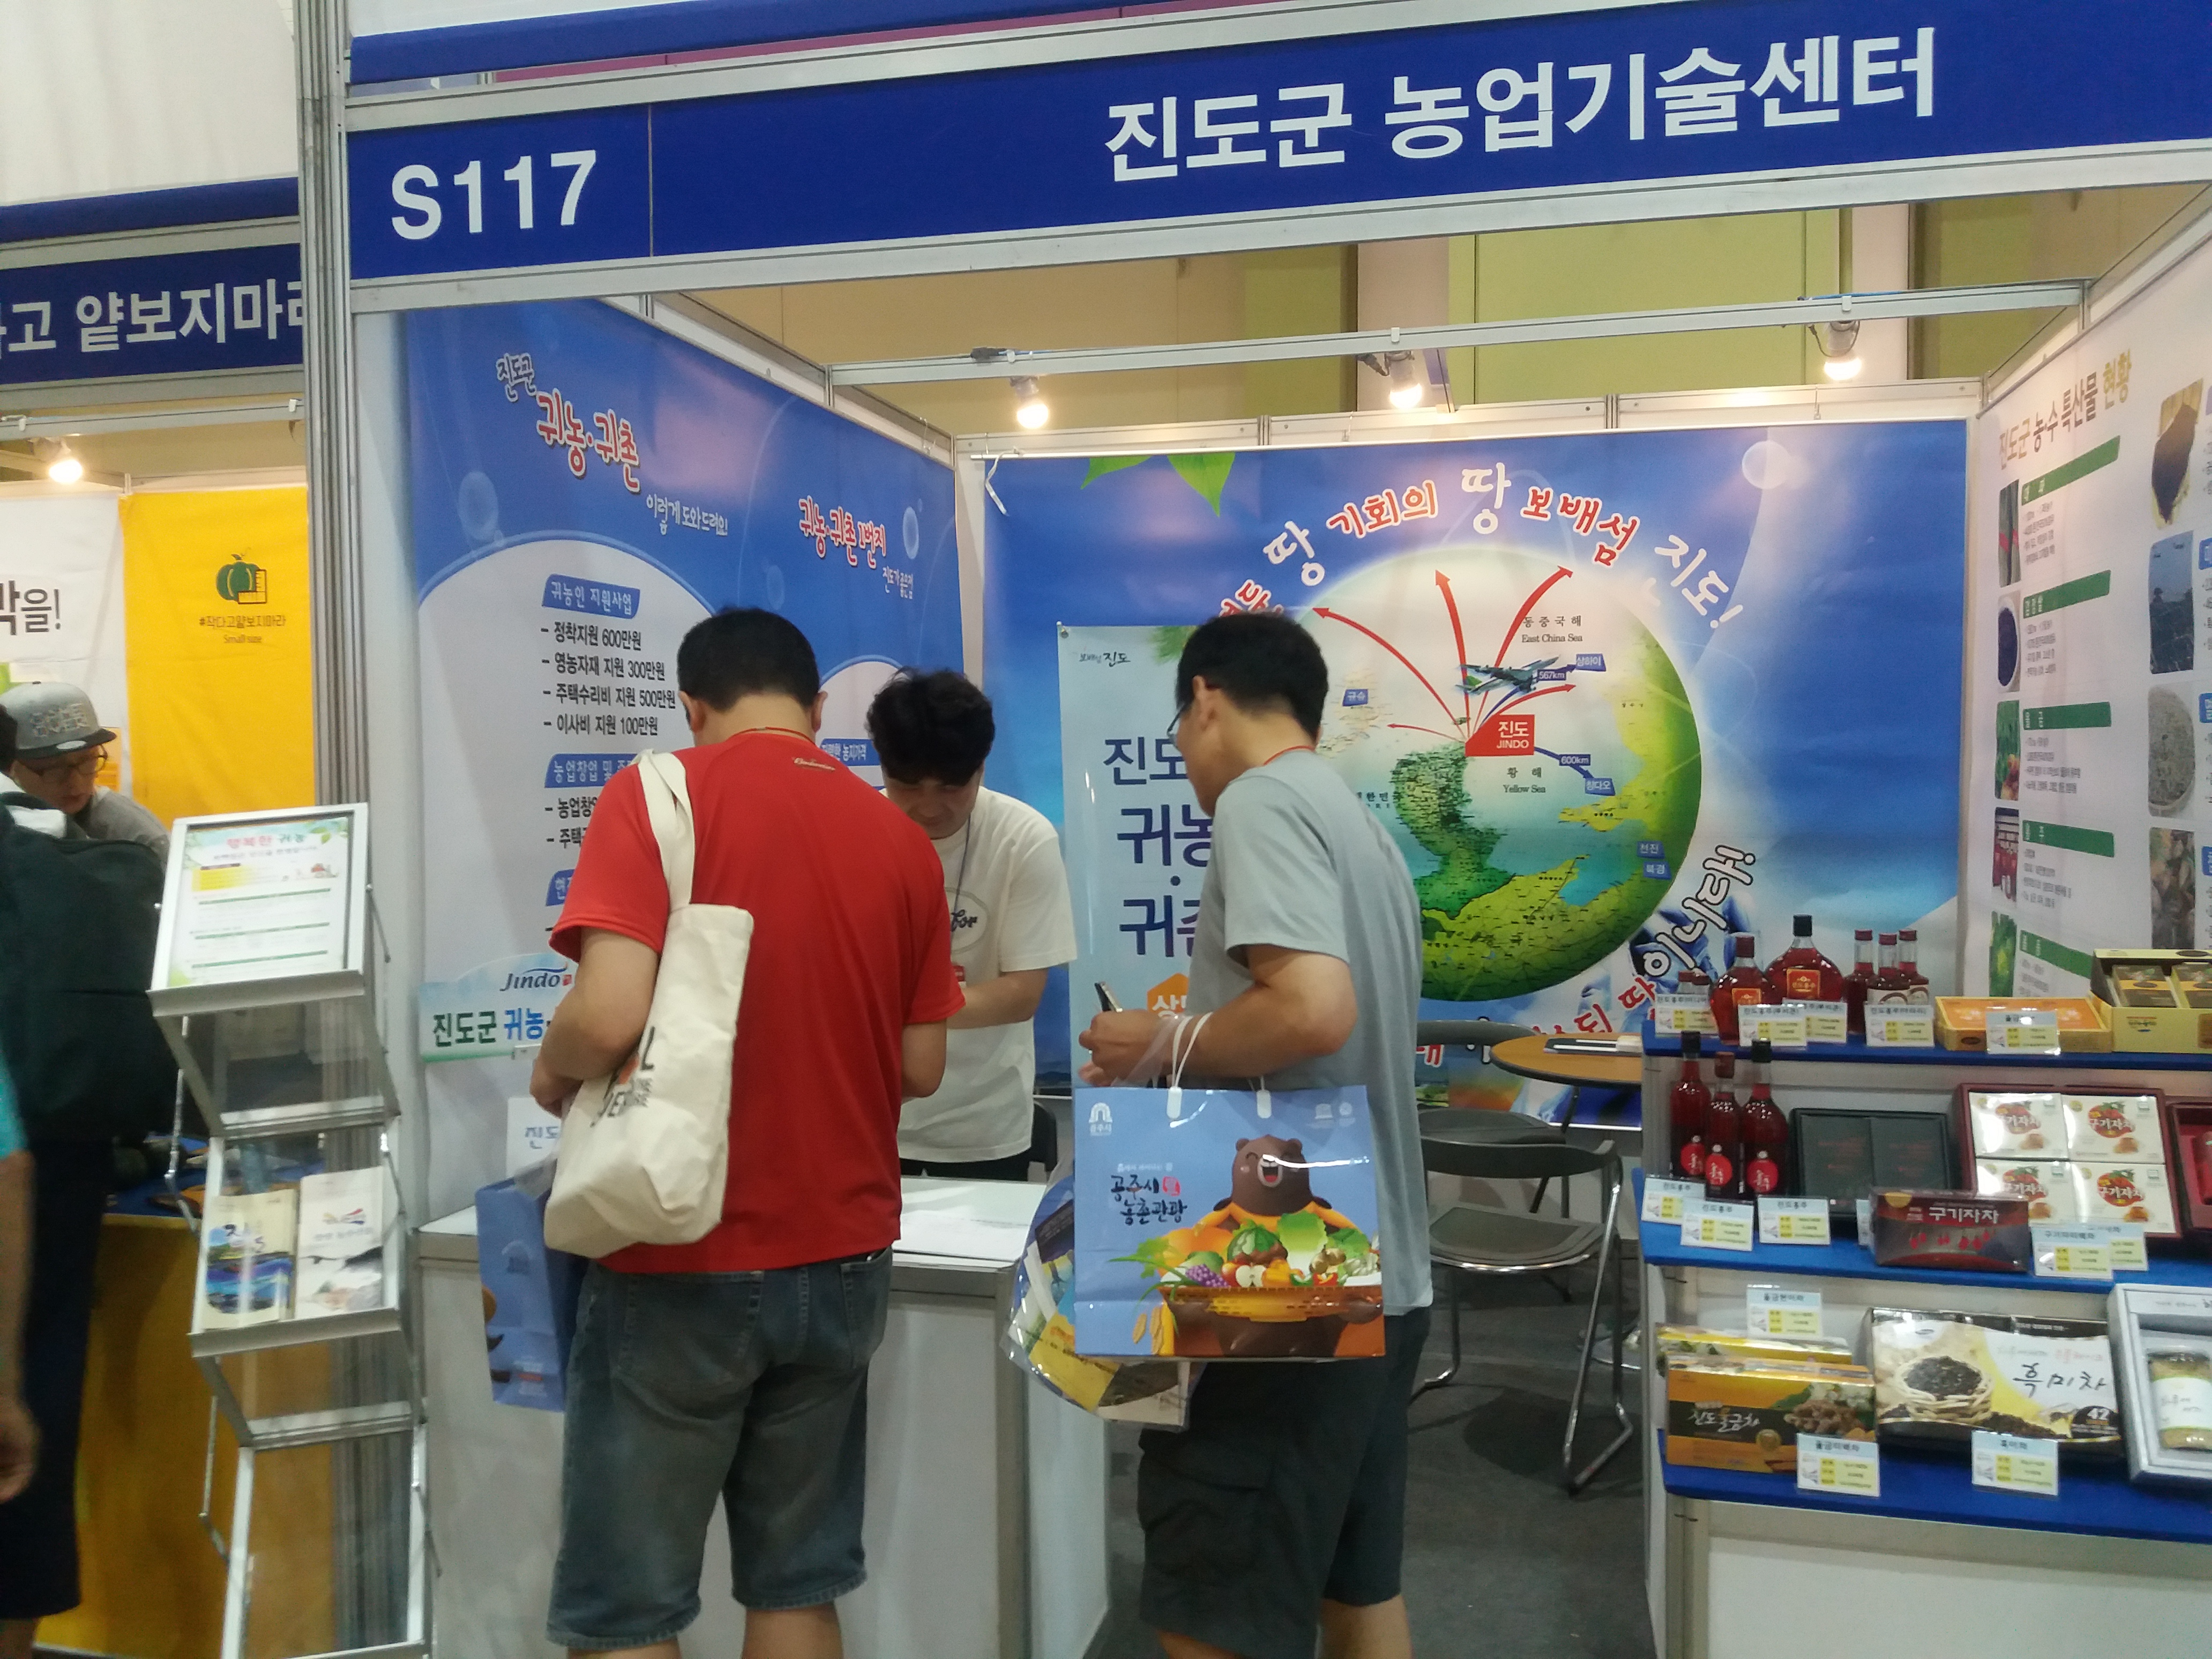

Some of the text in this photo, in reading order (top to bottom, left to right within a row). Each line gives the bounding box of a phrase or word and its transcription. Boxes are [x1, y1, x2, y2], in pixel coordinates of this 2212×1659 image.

[1104, 27, 1934, 182] 진도군 농업기술센터
[391, 150, 597, 241] S117
[0, 302, 56, 358] 고
[496, 352, 536, 402] 진도군
[2103, 349, 2132, 409] 현황
[647, 494, 680, 535] 이렇게
[858, 521, 886, 569] 1번지
[1262, 462, 1746, 629] 땅 기회의 땅 보배섬 진도!
[551, 581, 632, 615] 귀농인 지원사업
[223, 634, 262, 643] Small size
[554, 621, 641, 651] 정착지원 600만원
[1522, 634, 1582, 642] East China Sea
[555, 652, 665, 681] 영농자재 지원 300만원
[1103, 652, 1131, 667] 진도
[1576, 656, 1601, 666] 상하이
[556, 683, 676, 708] 주택수리비 지원 500만원
[557, 713, 657, 736] 이사비 지원 100만원
[1498, 721, 1529, 738] 진도
[1497, 740, 1529, 749] JINDO
[1503, 784, 1546, 793] Yellow Sea
[559, 826, 588, 848] 주택
[1117, 804, 1213, 866] 귀농
[500, 973, 561, 991] Jindo
[1152, 995, 1187, 1017] 상
[433, 1011, 496, 1048] 진도군
[1111, 1174, 1159, 1202] 공주시
[1120, 1197, 1187, 1225] 농촌관광
